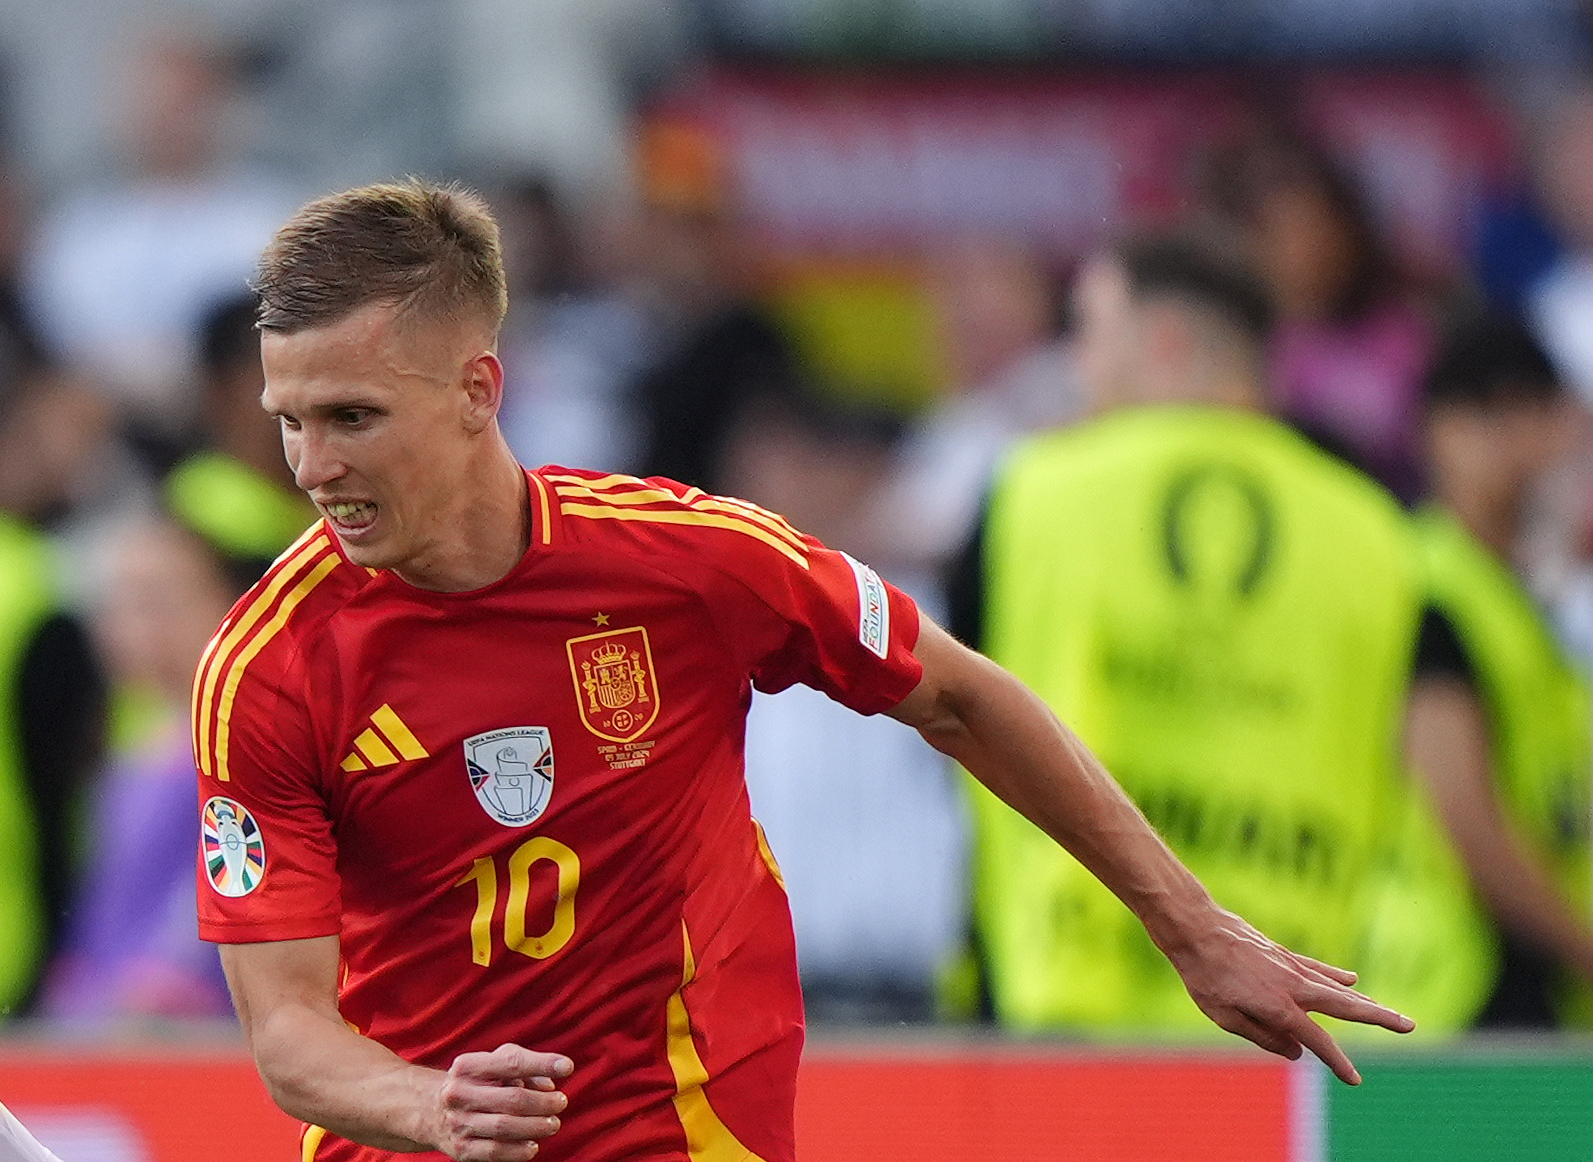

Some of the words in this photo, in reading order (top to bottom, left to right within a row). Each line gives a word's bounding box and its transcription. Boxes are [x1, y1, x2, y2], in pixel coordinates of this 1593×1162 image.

[864, 569, 880, 650] FOUNDAT
[517, 729, 544, 737] LEAGUE
[454, 836, 581, 967] 10
